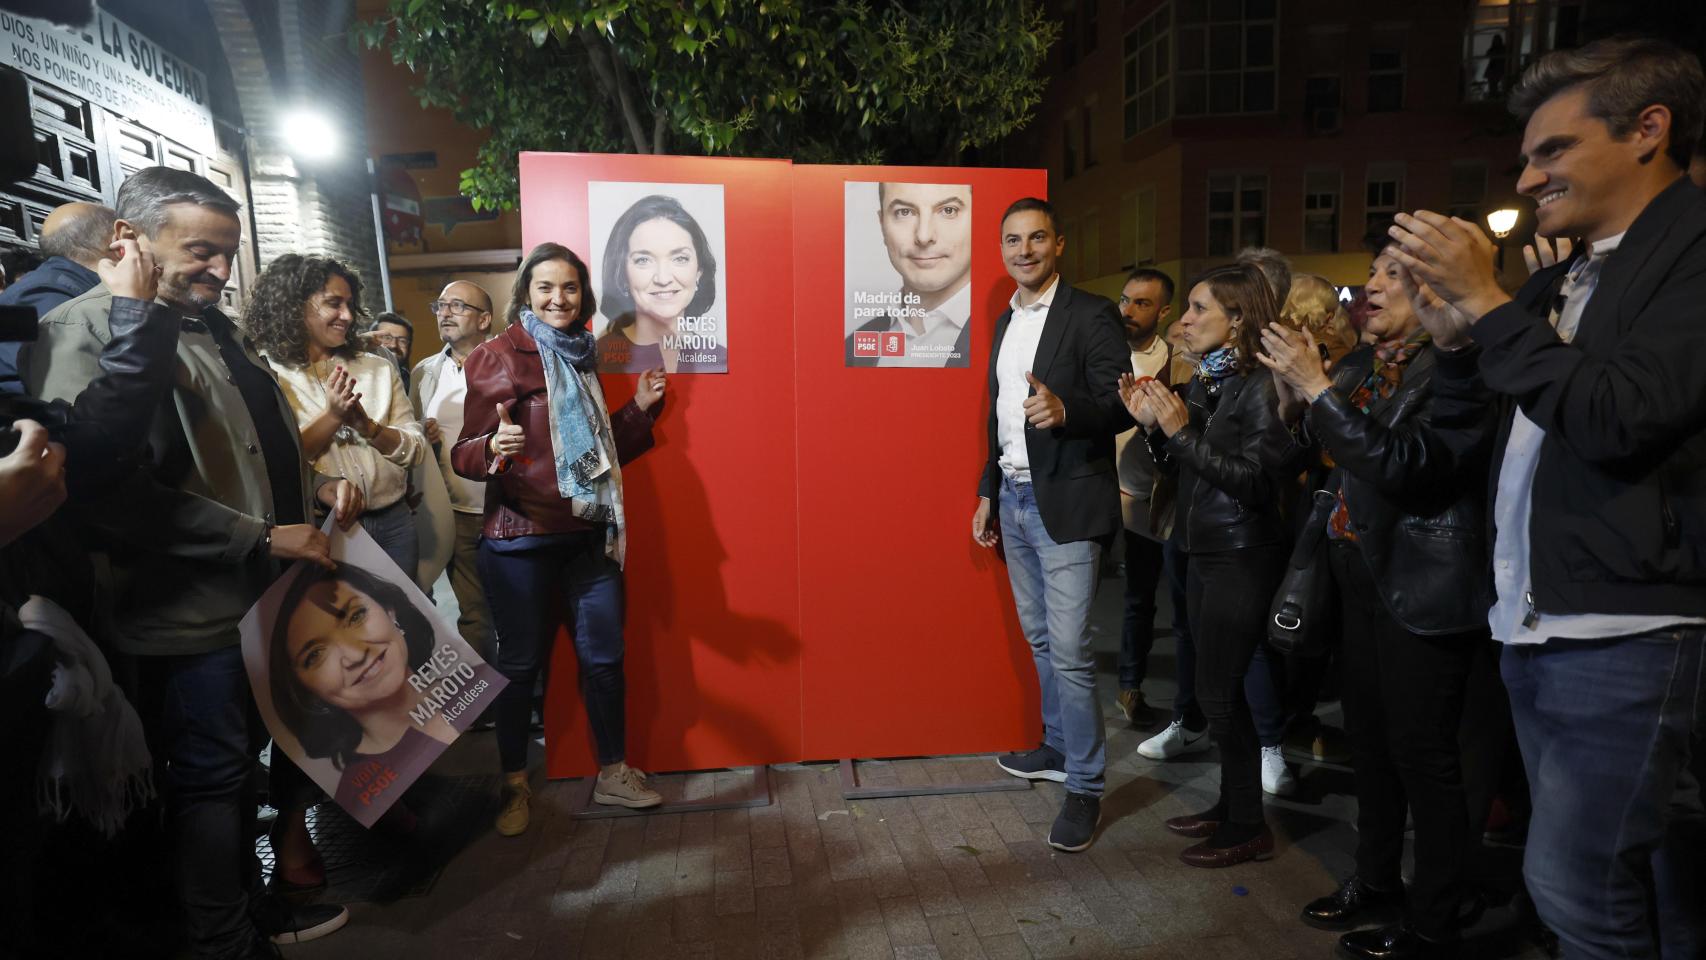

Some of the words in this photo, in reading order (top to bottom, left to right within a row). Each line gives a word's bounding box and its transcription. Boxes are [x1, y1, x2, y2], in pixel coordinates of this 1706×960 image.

[1, 13, 38, 48] DIOS,
[41, 32, 59, 55] UN
[62, 42, 90, 70] NIÑO
[93, 57, 99, 76] Y
[103, 63, 124, 85] UNA
[12, 42, 41, 71] NOS
[44, 57, 102, 98] PONEMOS
[98, 12, 126, 63] LA
[128, 32, 203, 106] SOLEDAD
[854, 292, 901, 304] Madrid
[903, 292, 921, 304] da
[854, 307, 886, 319] para
[663, 335, 717, 350] MAROTO
[677, 317, 716, 332] REYES
[677, 352, 717, 363] Alcaldesa
[407, 643, 459, 694] REYES
[408, 662, 475, 727] MAROTO
[441, 679, 489, 725] Alcaldesa
[358, 768, 398, 807] PSOE
